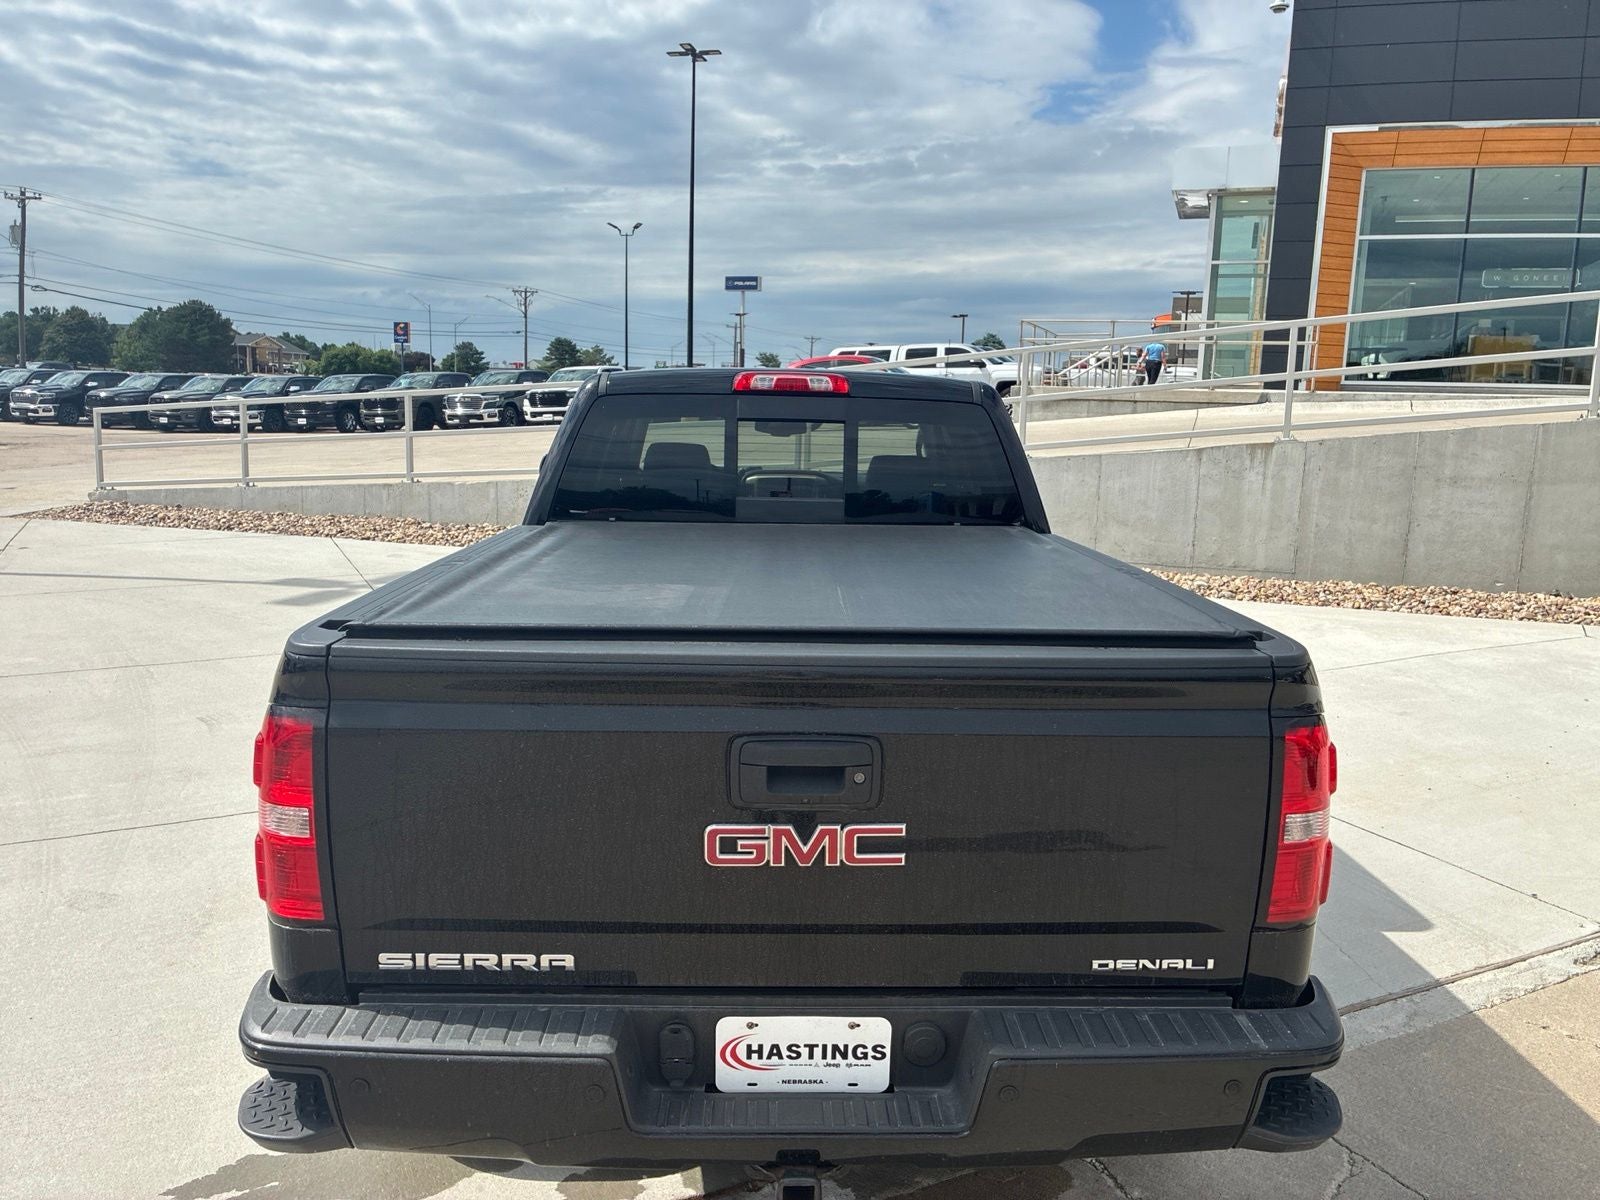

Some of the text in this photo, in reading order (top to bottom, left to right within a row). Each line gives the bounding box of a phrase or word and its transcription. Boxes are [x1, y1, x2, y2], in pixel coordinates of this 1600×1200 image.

[704, 823, 906, 867] GMC
[378, 952, 575, 971] SIERRA
[1091, 958, 1215, 971] DENALI
[746, 1043, 887, 1061] HASTINGS
